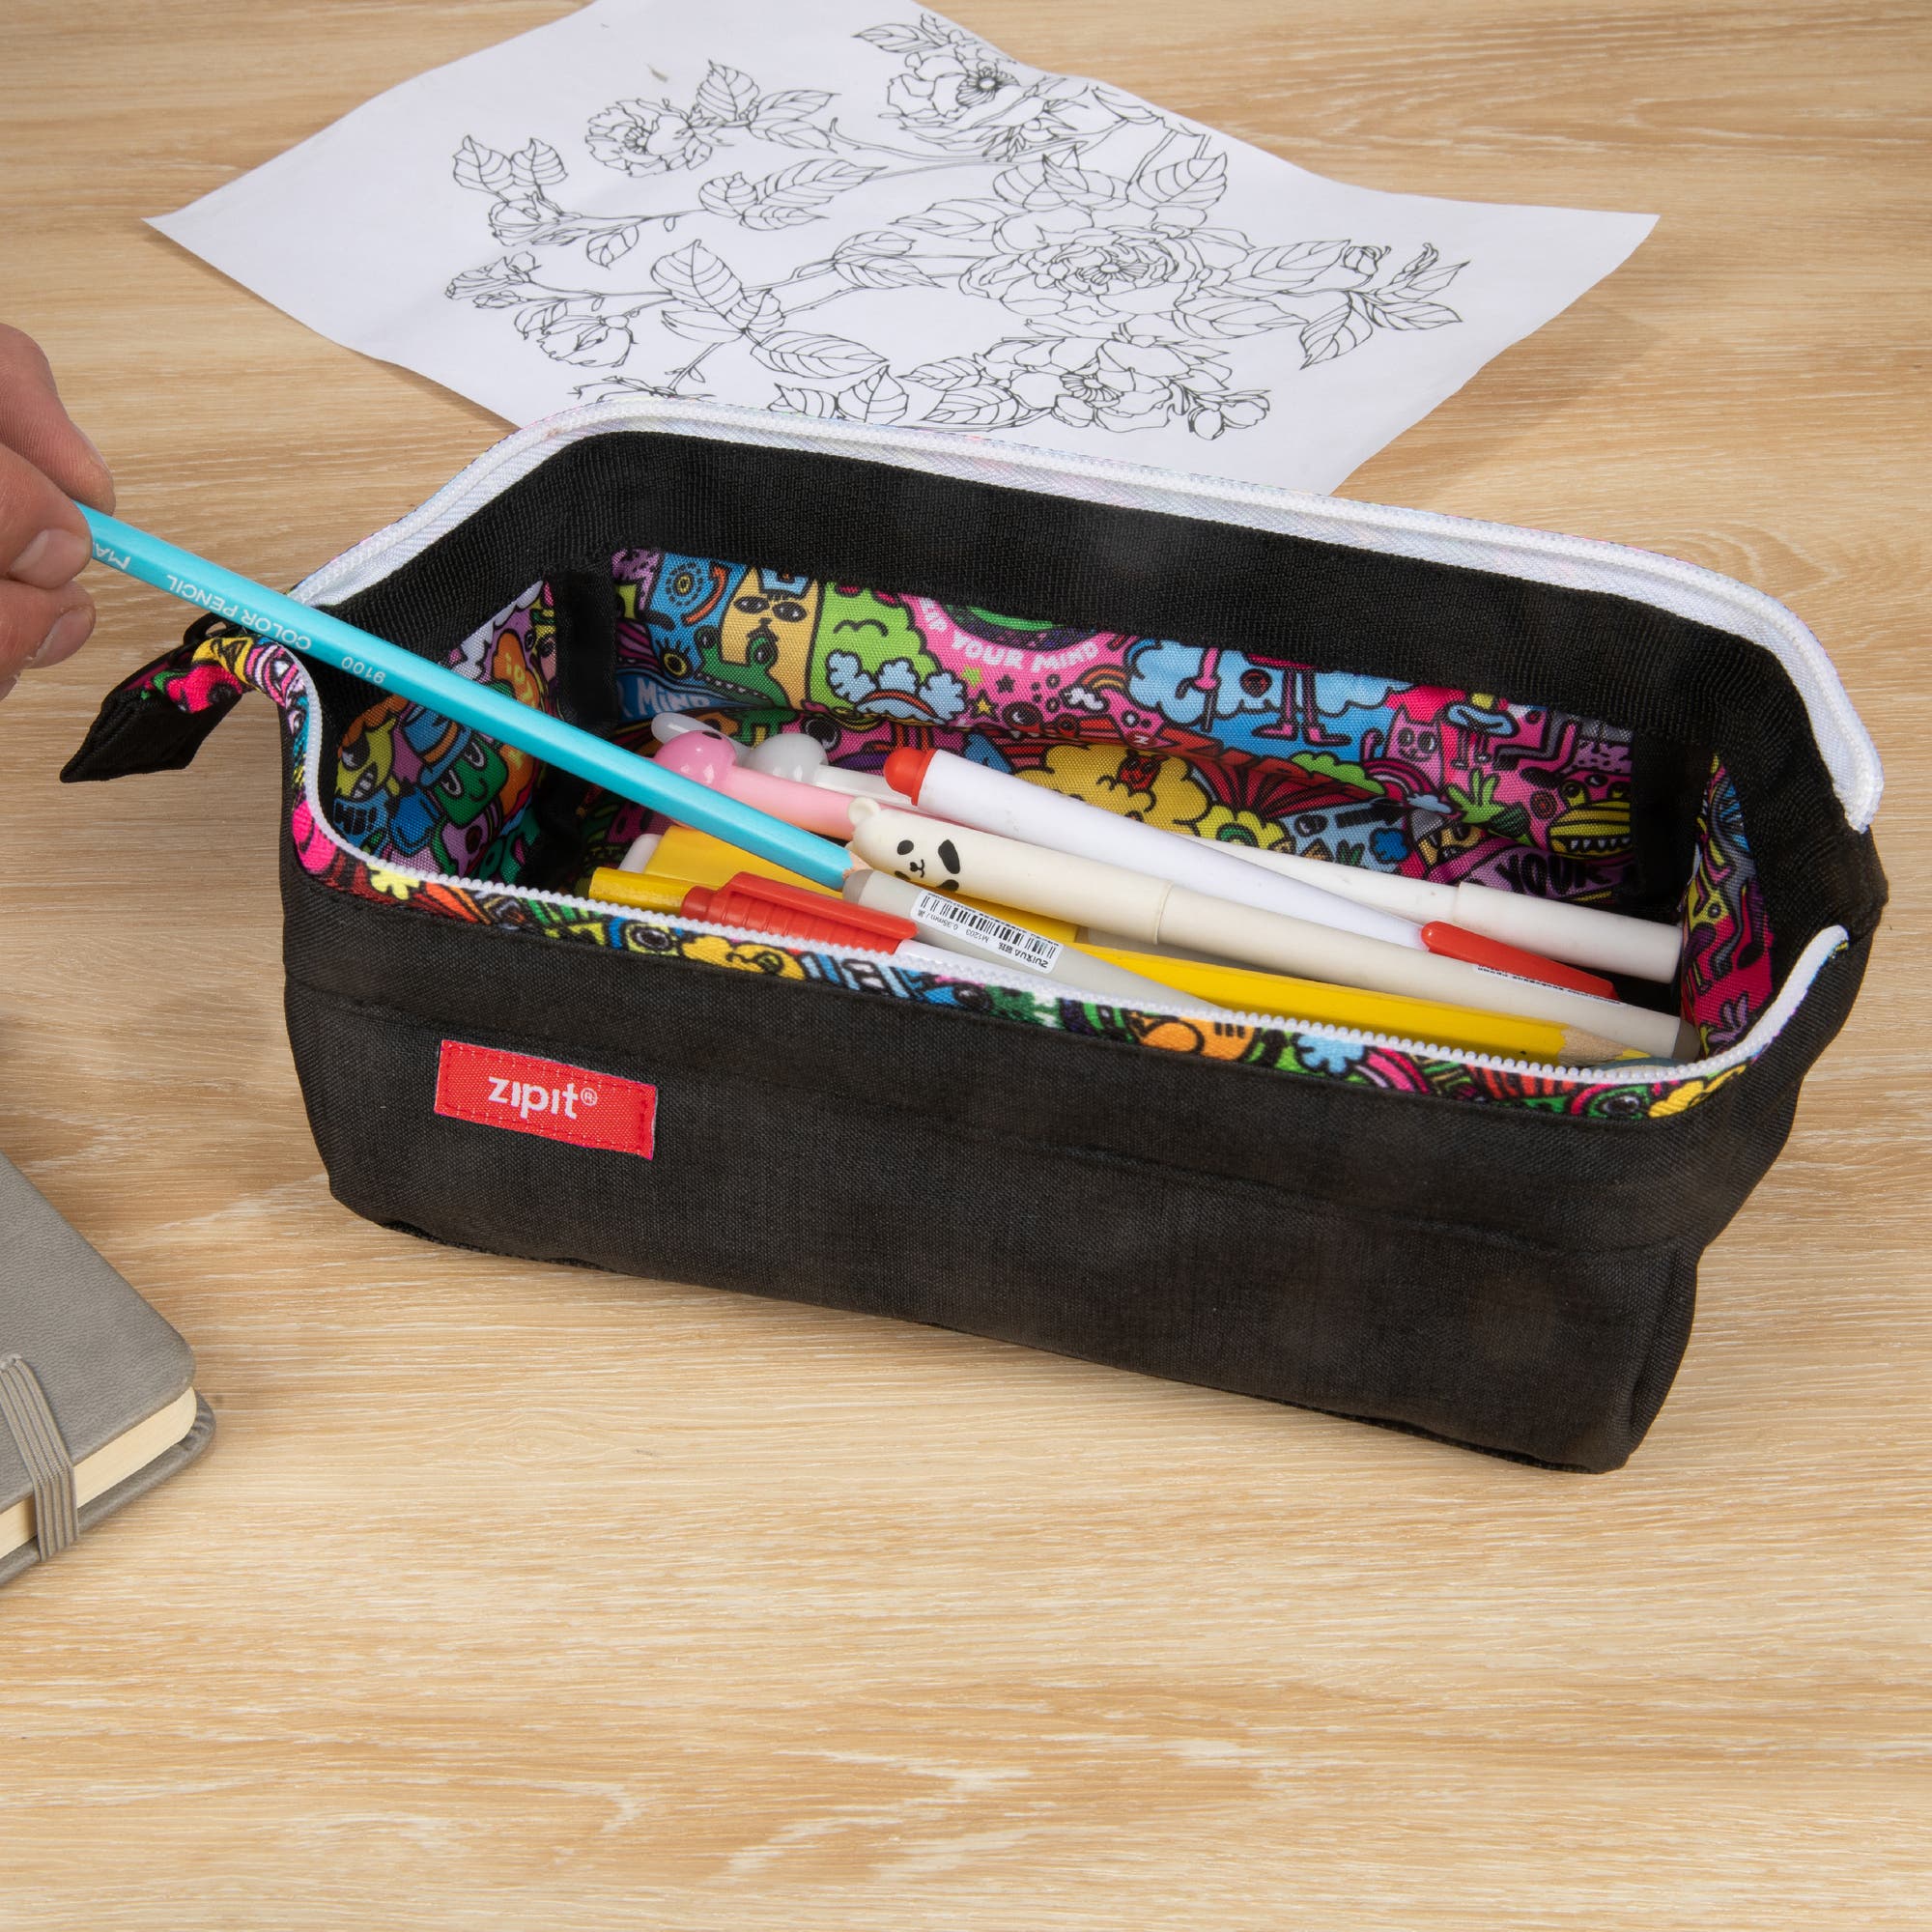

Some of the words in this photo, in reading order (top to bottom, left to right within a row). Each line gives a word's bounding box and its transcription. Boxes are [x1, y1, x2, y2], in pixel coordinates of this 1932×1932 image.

[93, 541, 131, 570] MA
[166, 574, 239, 619] PENCIL
[242, 609, 311, 651] COLOR
[342, 656, 386, 684] 9100
[952, 632, 1024, 669] YOUR
[1031, 641, 1098, 672] MIND
